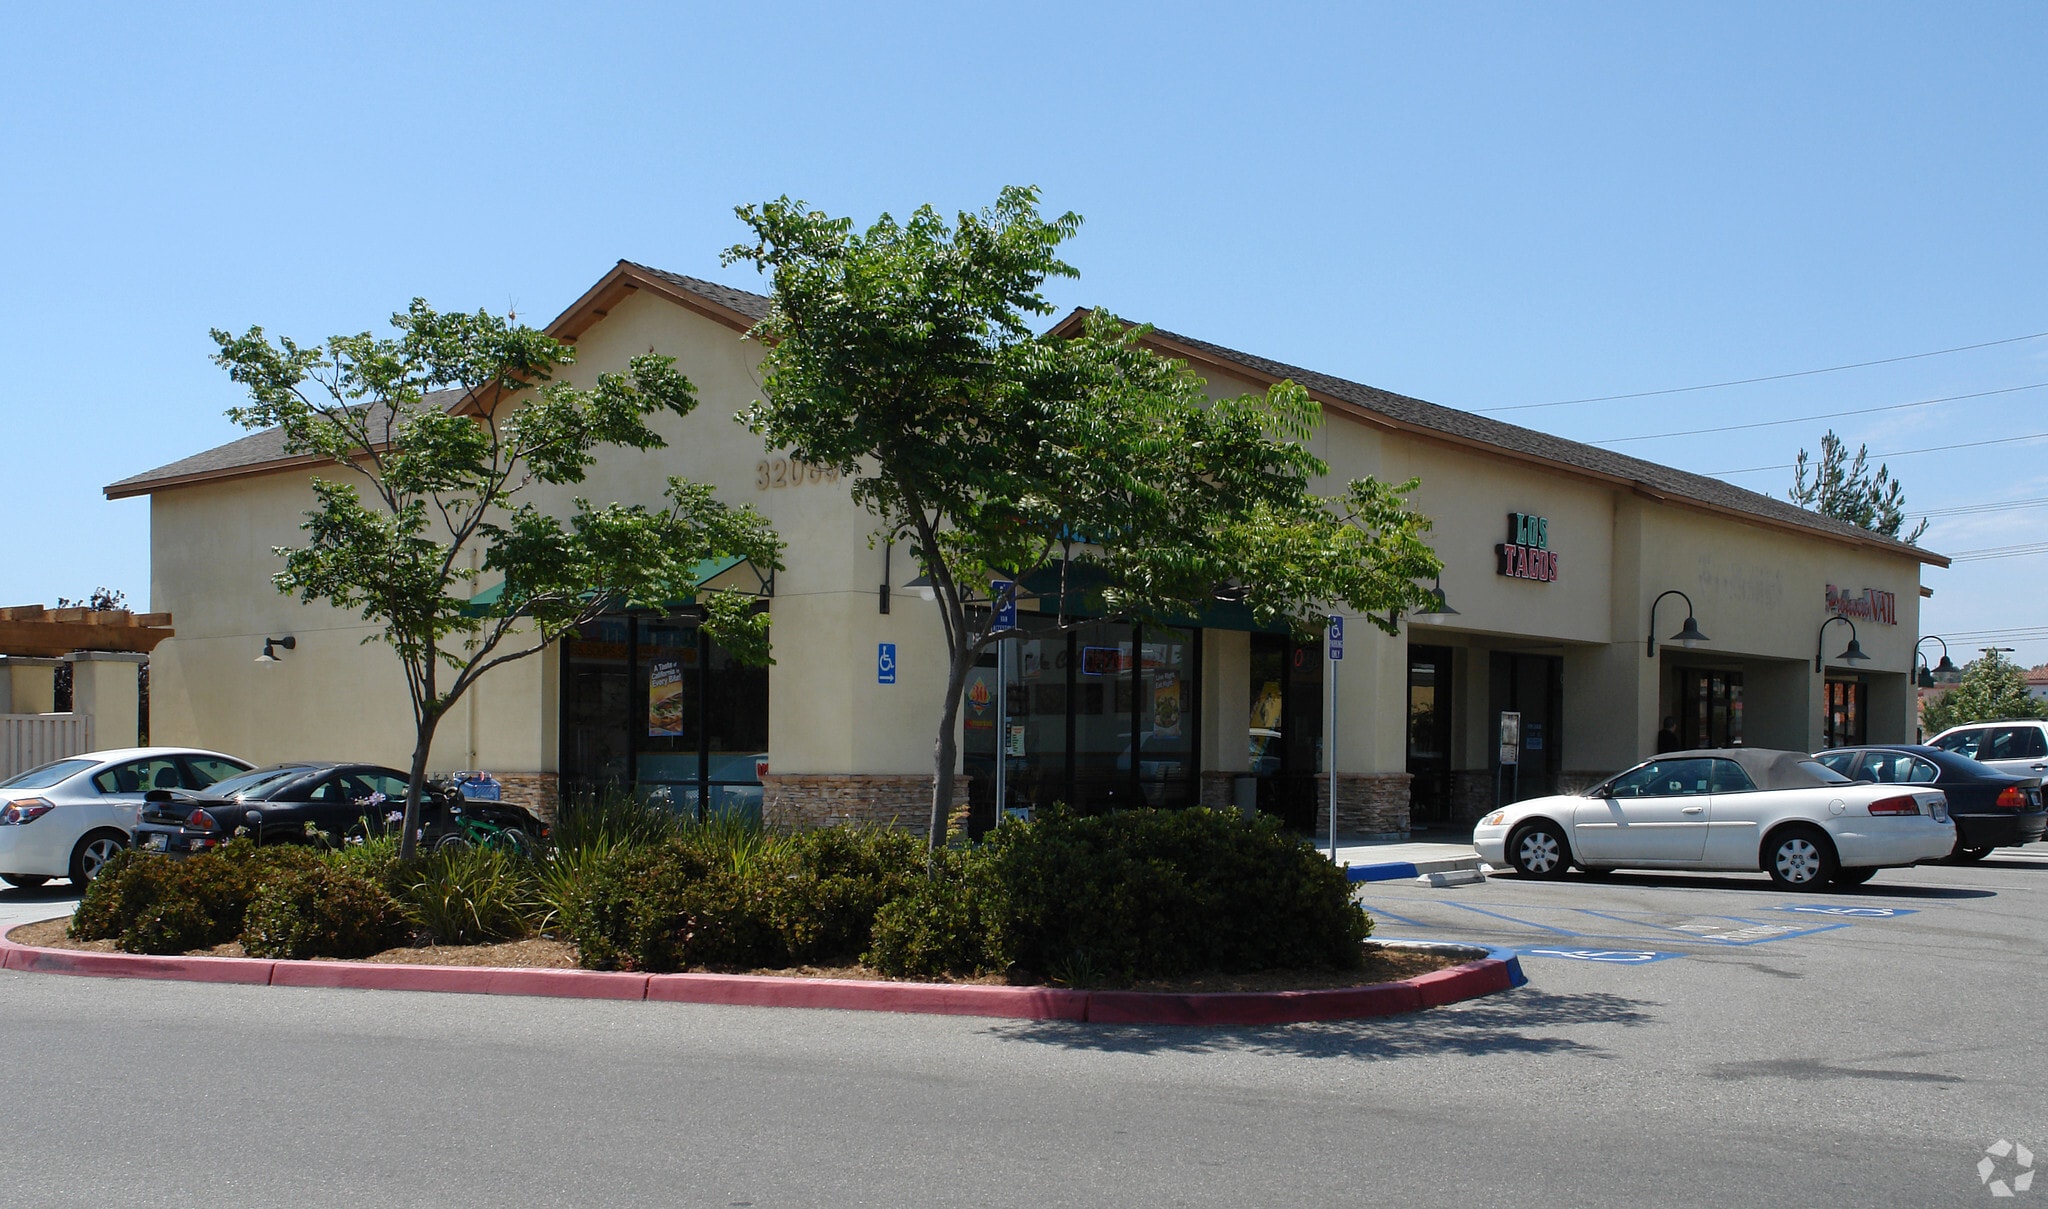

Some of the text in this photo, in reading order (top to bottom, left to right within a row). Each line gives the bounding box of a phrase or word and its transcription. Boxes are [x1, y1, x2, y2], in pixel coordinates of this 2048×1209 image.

[1514, 512, 1549, 549] LOS
[1502, 543, 1559, 582] TACOS
[652, 678, 668, 688] Every
[974, 685, 988, 701] 30
